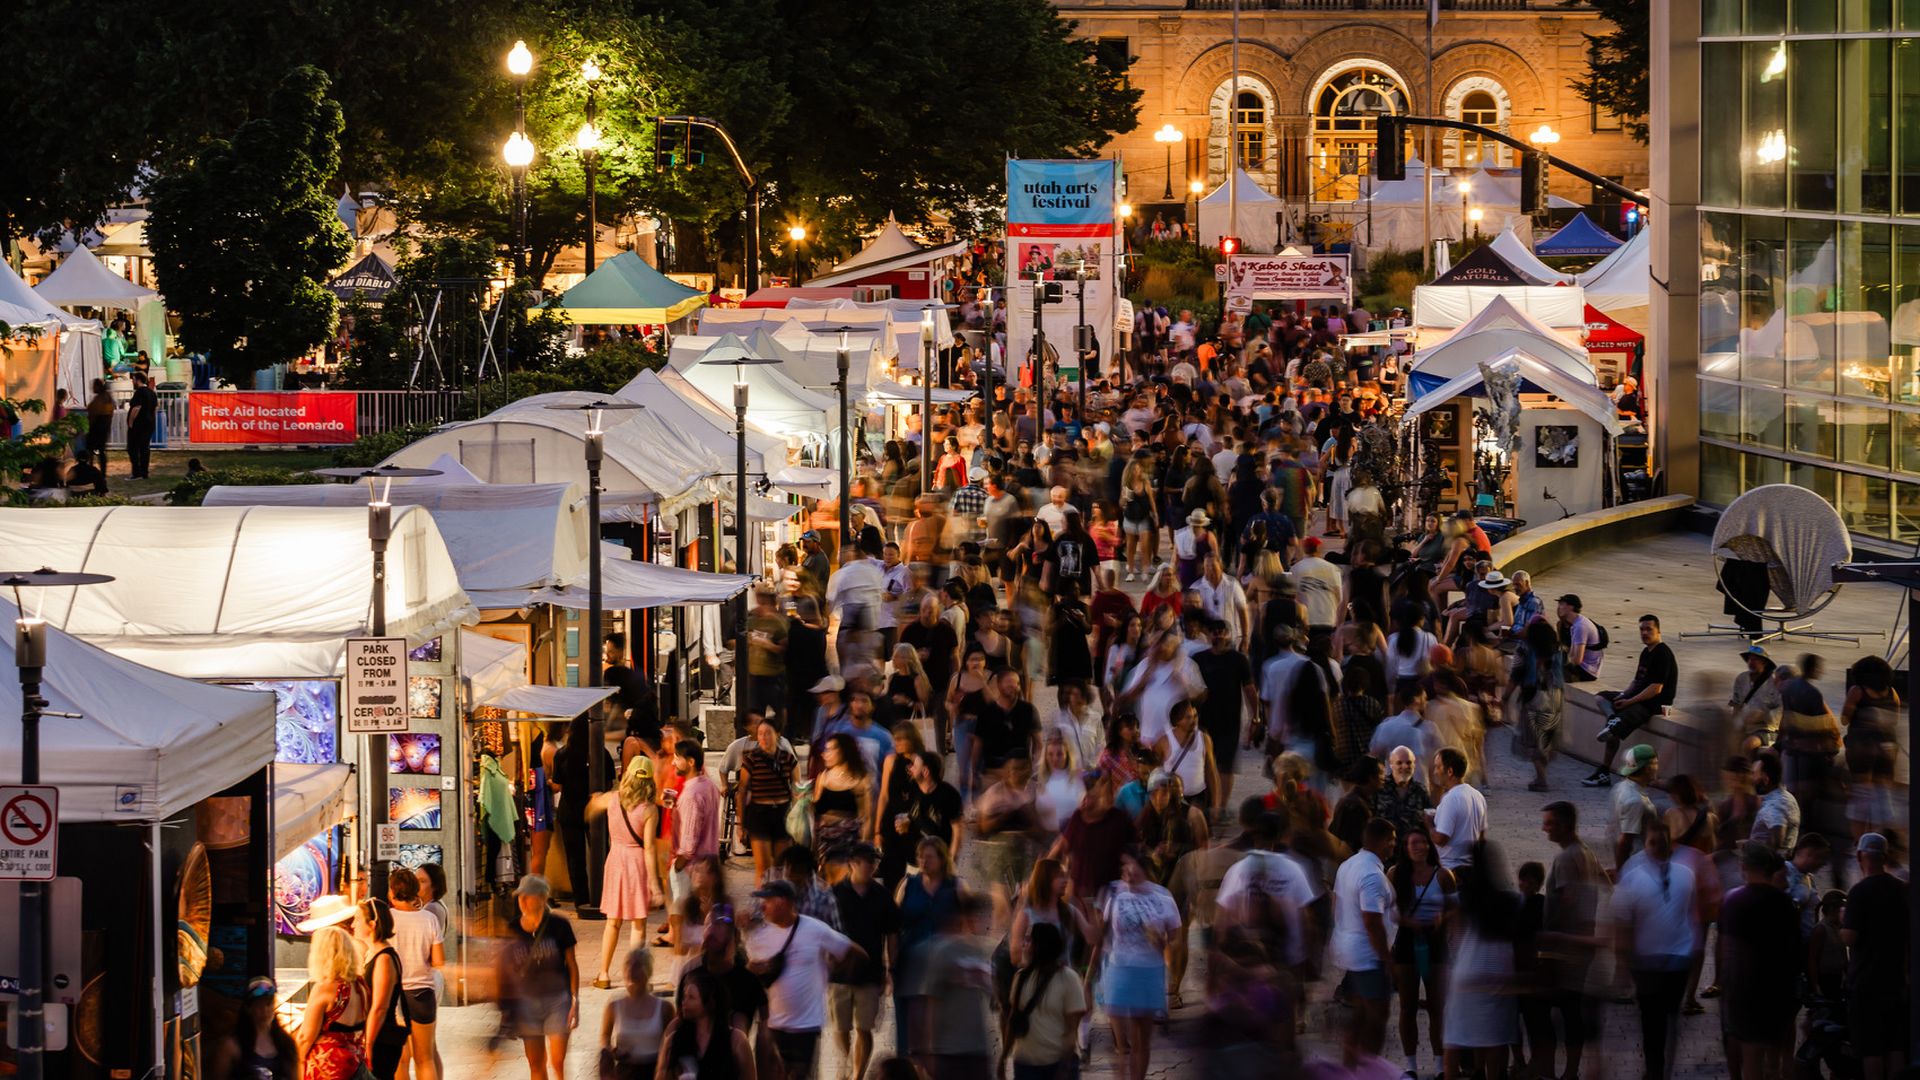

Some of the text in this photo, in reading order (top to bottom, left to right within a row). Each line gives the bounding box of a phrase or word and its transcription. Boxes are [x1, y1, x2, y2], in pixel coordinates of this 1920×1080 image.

[1024, 181, 1098, 194] utah arts
[1032, 195, 1090, 208] festival
[1248, 261, 1329, 272] Kabob Shack
[1453, 273, 1509, 281] NATURALS
[333, 278, 392, 288] SAN DIABLO
[202, 406, 306, 416] First Aid located
[202, 420, 344, 430] North of the Leonardo
[363, 645, 389, 654] PARK
[357, 656, 397, 666] CLOSED
[363, 669, 391, 678] FROM
[354, 707, 402, 717] CERDO
[0, 849, 49, 859] ENTIRE PARK
[35, 863, 51, 871] CODE
